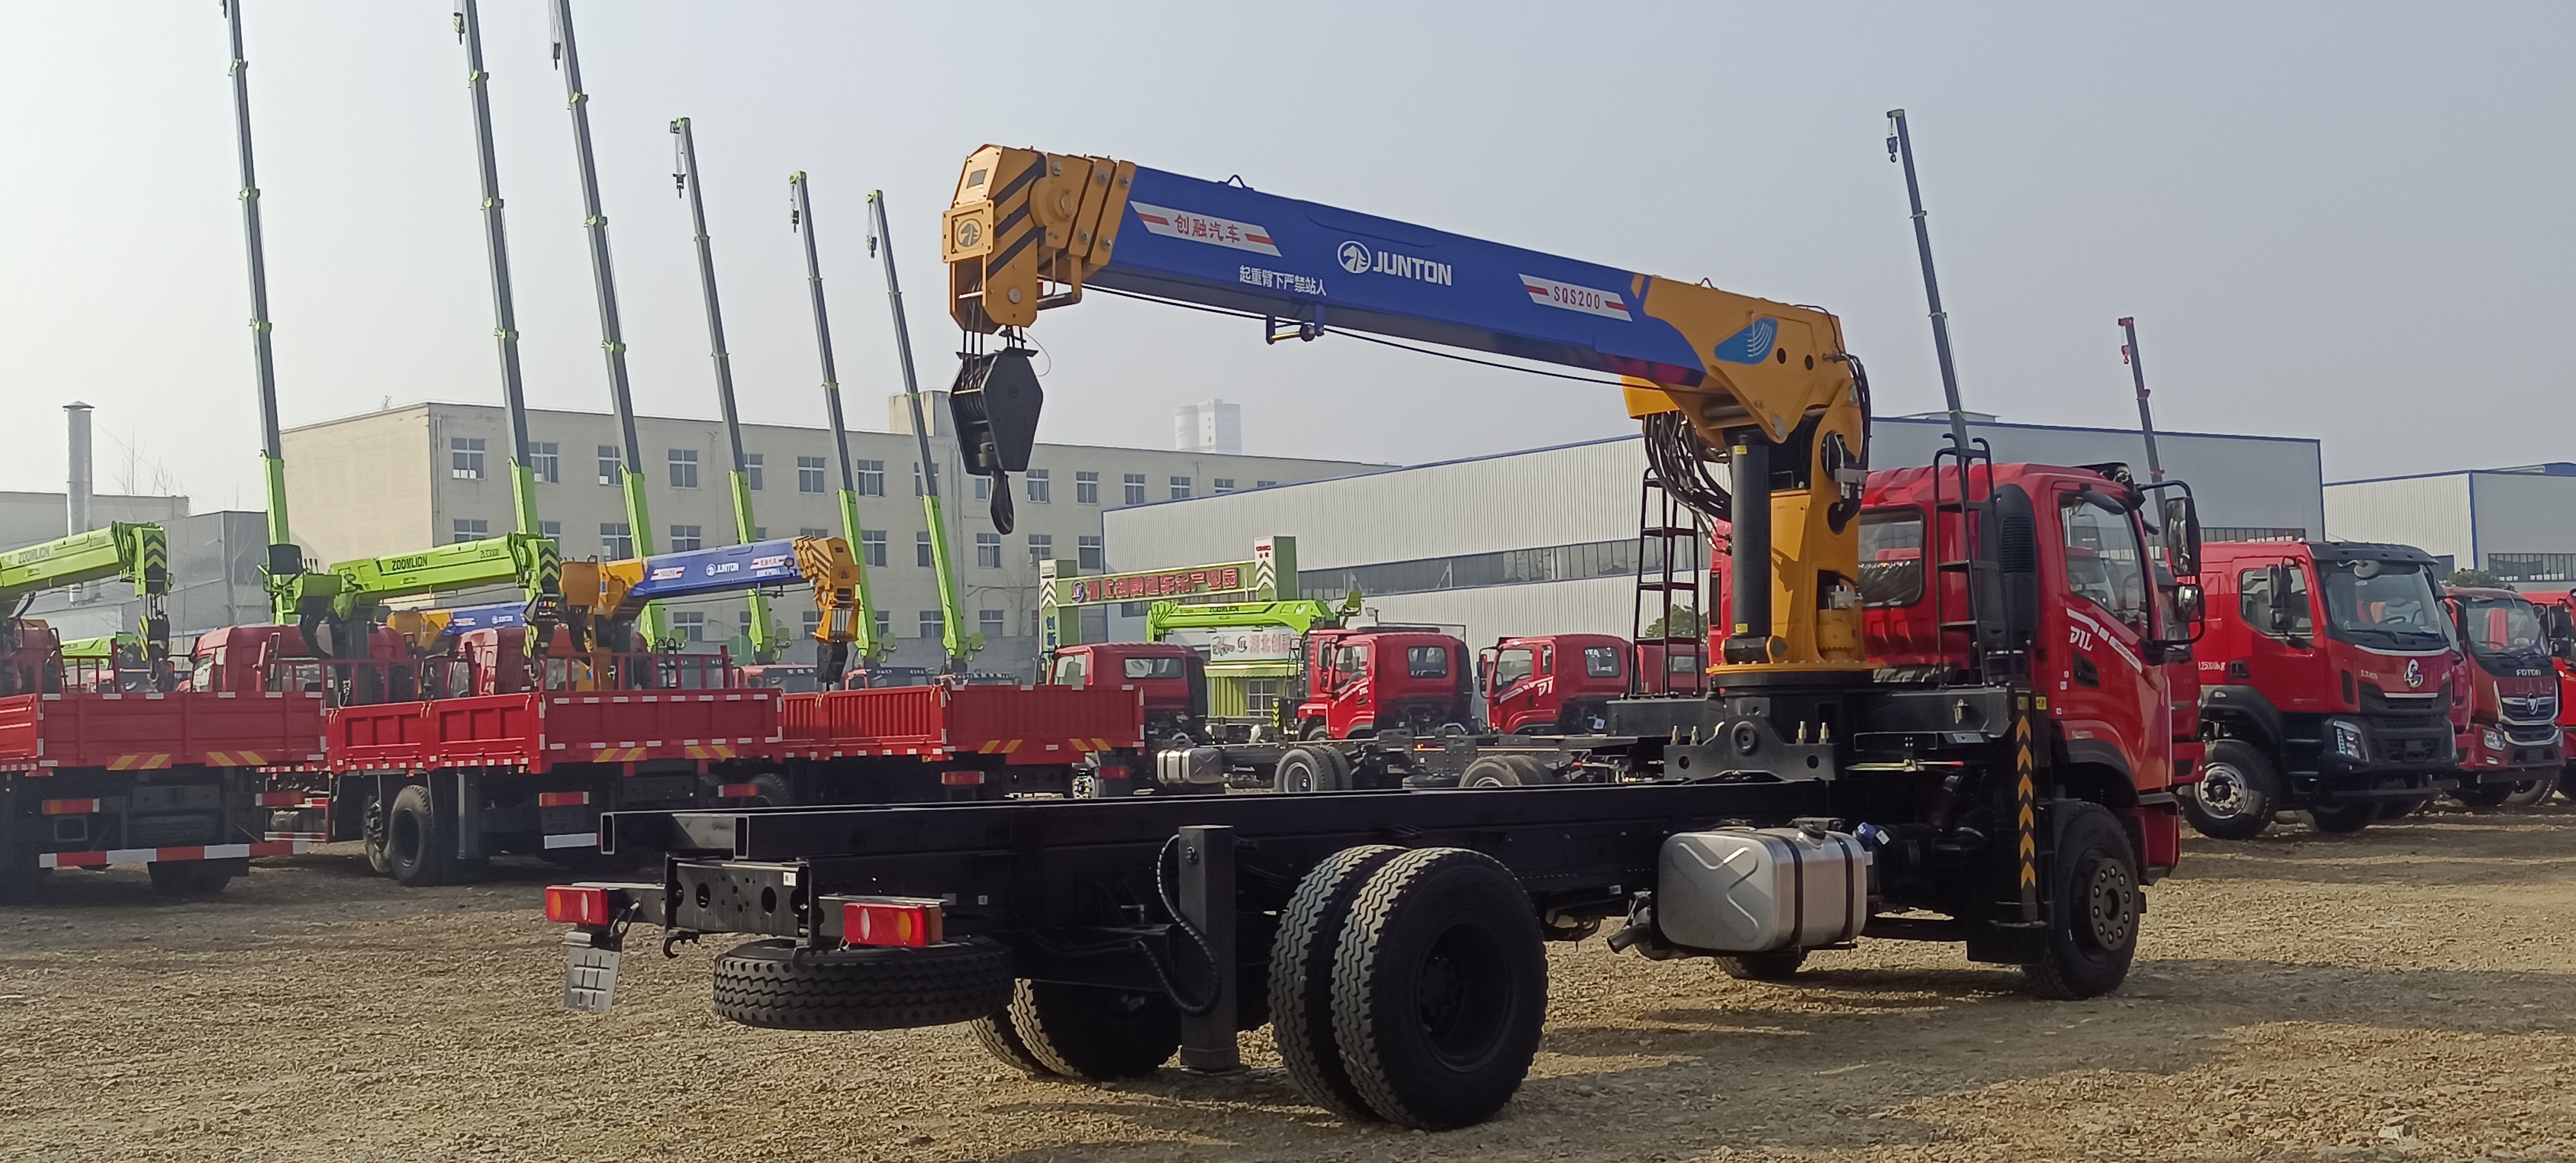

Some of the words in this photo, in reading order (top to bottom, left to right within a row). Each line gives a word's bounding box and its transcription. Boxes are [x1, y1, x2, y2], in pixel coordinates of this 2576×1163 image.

[1175, 214, 1240, 243] 创融汽车
[1239, 264, 1327, 296] 起重臂下严禁站人
[1373, 251, 1452, 286] JUNTON
[1554, 286, 1600, 309] SQS200
[392, 555, 428, 571] ZOOMLION
